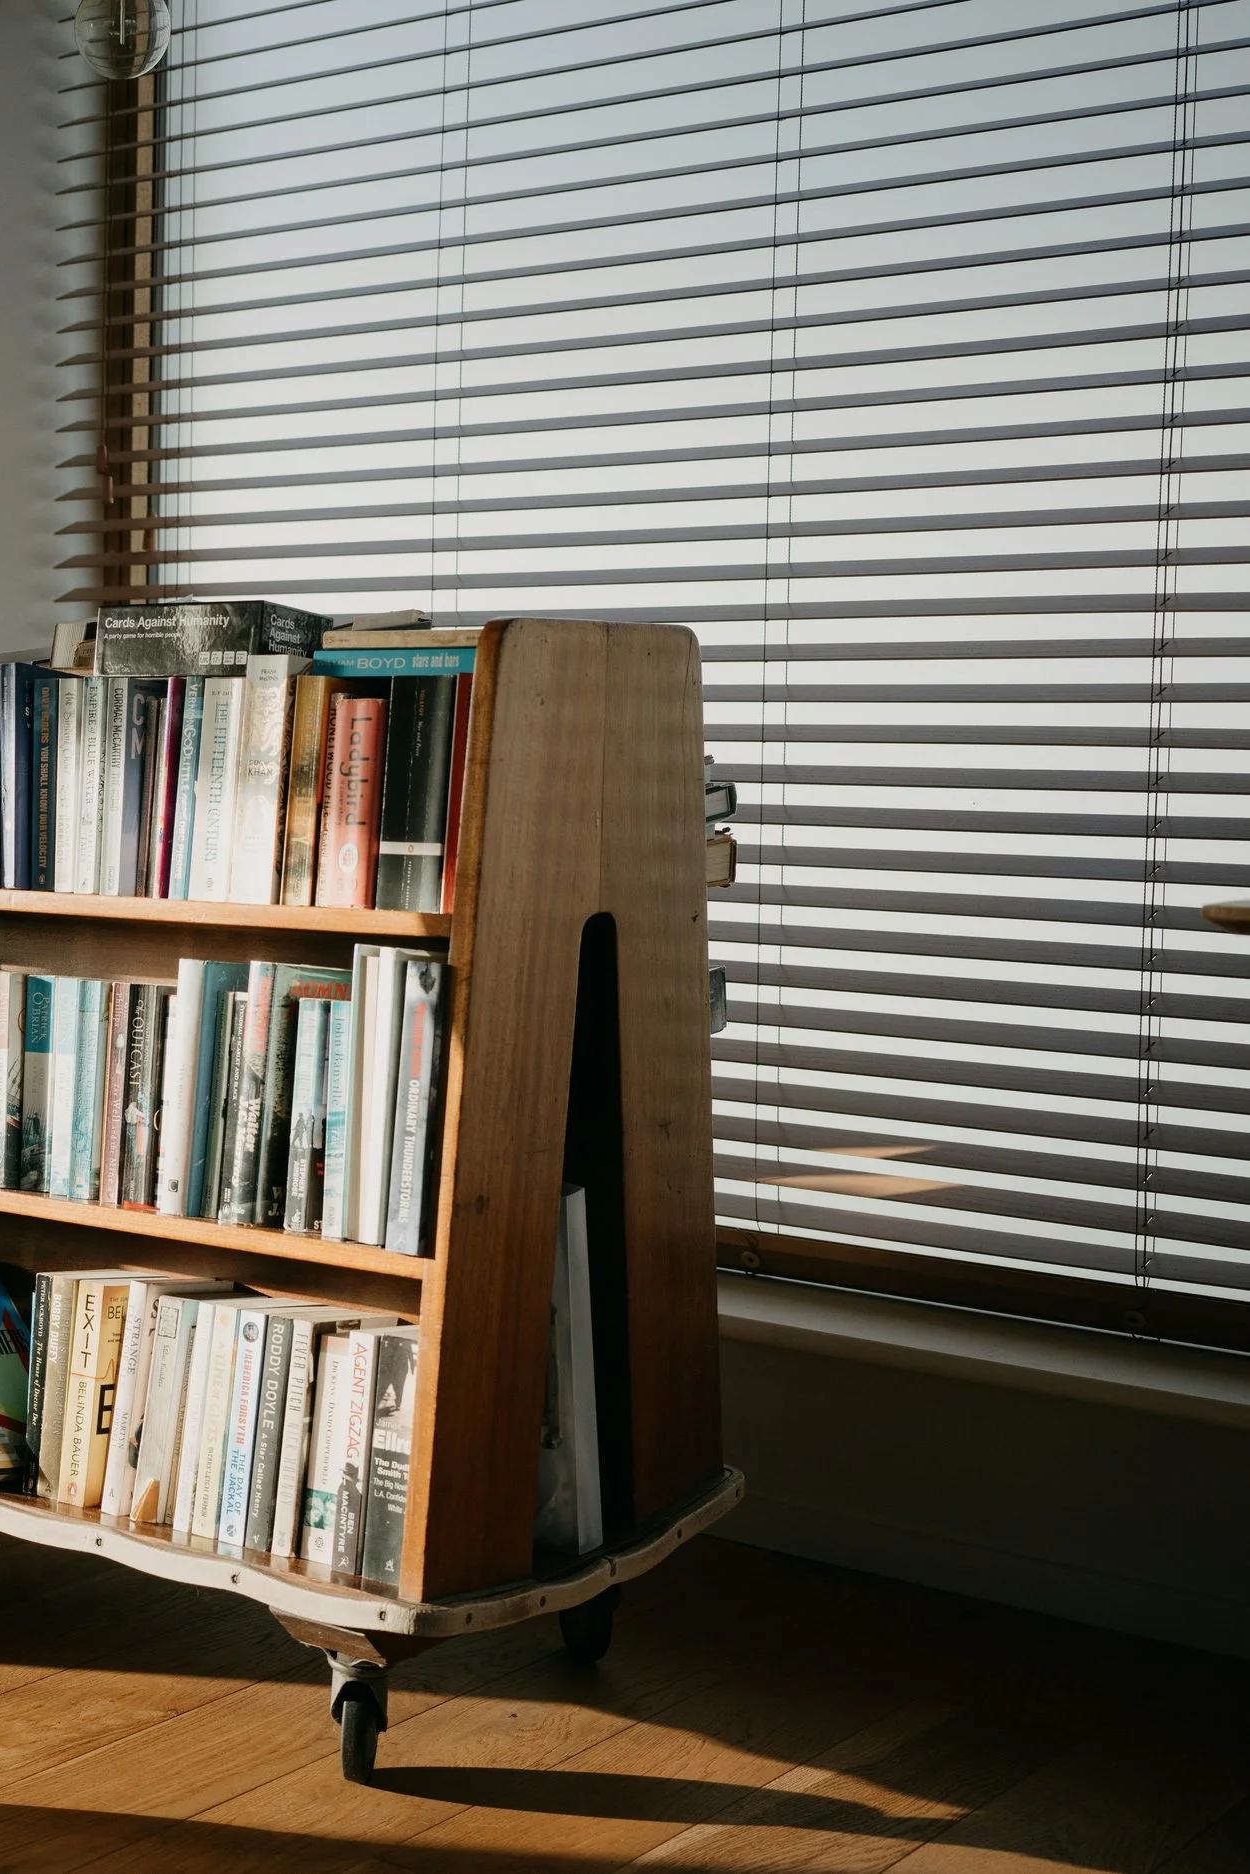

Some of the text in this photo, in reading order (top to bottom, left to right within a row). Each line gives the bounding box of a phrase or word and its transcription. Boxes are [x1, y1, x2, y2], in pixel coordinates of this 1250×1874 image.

[104, 614, 230, 631] Cards Against Humanity
[109, 633, 121, 643] party
[122, 633, 136, 642] game
[137, 632, 145, 640] for
[145, 631, 164, 640] horrible
[269, 627, 301, 646] Against
[270, 614, 295, 634] Cards
[356, 650, 460, 670] BOYD stars and bars
[113, 687, 124, 723] CORMAC
[217, 702, 228, 724] THE
[85, 686, 98, 804] EMPIRE BLUE WATER
[111, 725, 122, 769] McCARTHY
[180, 683, 199, 791] VERNON LITTLE
[38, 687, 50, 869] DAVE EGGERS YOU SHALL KNOW OUR VELOCITY
[210, 727, 227, 804] FIFTEENTH
[339, 716, 373, 827] Ladybird
[30, 991, 44, 1043] O'BRIAN
[39, 995, 51, 1040] PATRICK
[112, 991, 123, 1028] Phillips
[128, 1016, 145, 1088] OUTCAST
[234, 1040, 243, 1065] SCARLET
[331, 1016, 347, 1105] John Banville
[110, 1125, 118, 1140] and
[111, 1098, 121, 1123] Well
[245, 1097, 261, 1153] Walter
[403, 1079, 420, 1133] ORDINARY
[107, 1156, 118, 1183] Mine
[231, 1126, 246, 1188] Murray
[291, 1160, 300, 1197] AMBROSE
[297, 1158, 307, 1192] STEPHEN
[396, 1135, 416, 1224] THUNDERSTORMS
[31, 1280, 47, 1427] PETER ACKROYD The House of Doctor Dee
[48, 1293, 62, 1364] BOBBY DUFFY
[80, 1294, 96, 1369] EXIT
[126, 1317, 143, 1375] STRANGE
[157, 1362, 168, 1388] Kundera
[236, 1348, 254, 1445] FREDERICK FORSYTH
[285, 1333, 309, 1449] FEVER PITCH NICK
[345, 1342, 369, 1459] AGENT ZIGZAG
[53, 1373, 67, 1437] PERCEPTION
[69, 1381, 88, 1477] BELINDA BAUER
[117, 1411, 129, 1450] MARTYN
[251, 1323, 286, 1518] RODDY DOYLE A Star Called Henry
[204, 1471, 214, 1493] LEIGH
[225, 1449, 240, 1515] THE JACKAL
[234, 1452, 246, 1517] THE DAY OF
[374, 1456, 390, 1468] The
[377, 1466, 402, 1481] Smith
[336, 1490, 350, 1554] MACINTYRE
[346, 1511, 357, 1535] BEN
